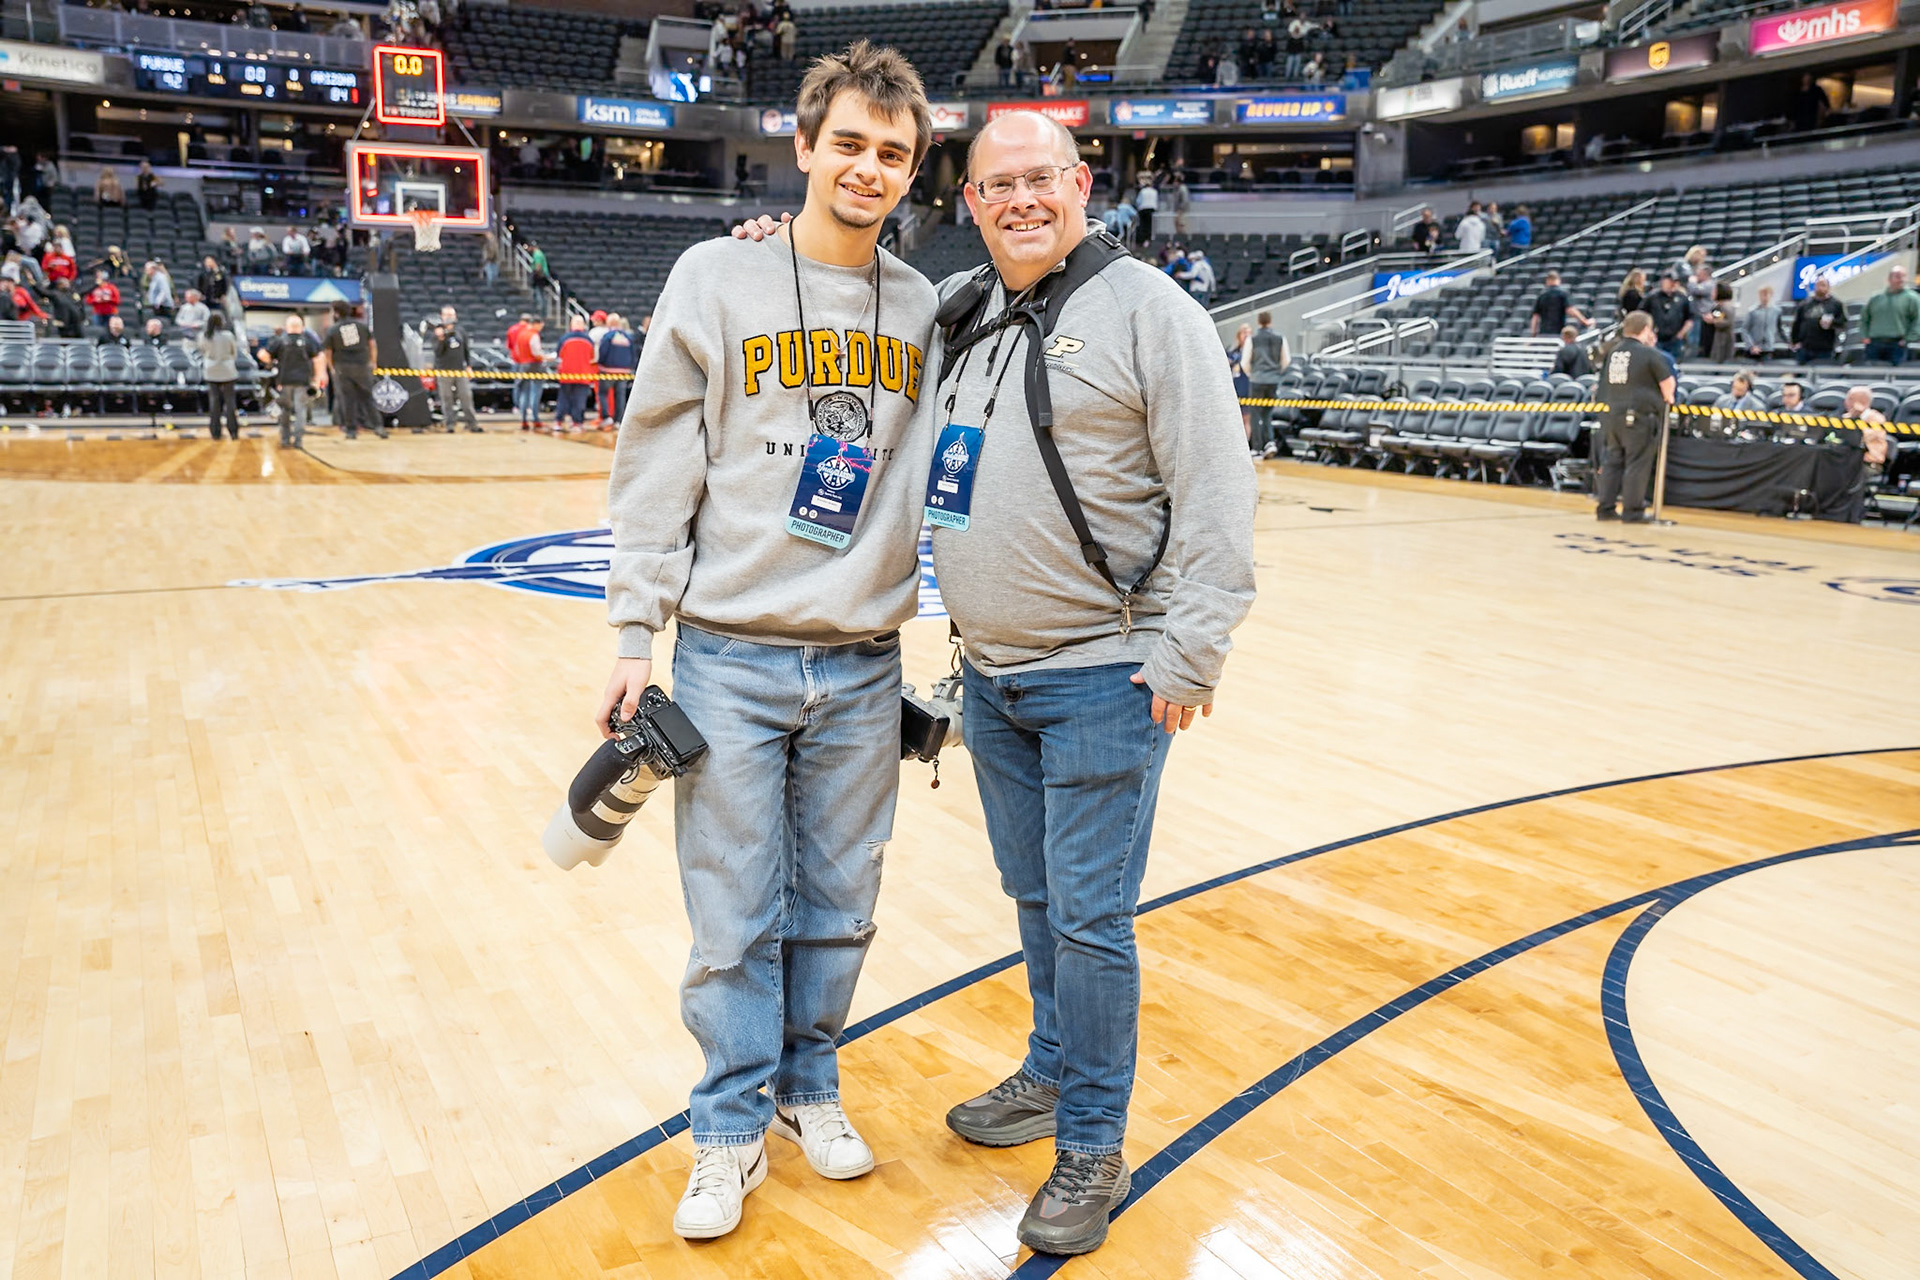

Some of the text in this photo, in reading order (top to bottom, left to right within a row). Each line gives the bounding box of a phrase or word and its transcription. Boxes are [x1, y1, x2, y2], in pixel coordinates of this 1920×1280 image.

[1806, 7, 1861, 41] mhs
[18, 51, 99, 75] Kinetico
[139, 54, 186, 74] PURDUE
[393, 54, 423, 76] 0.0
[310, 69, 357, 88] ARIZONA
[1499, 67, 1540, 92] Ruoff
[584, 98, 631, 124] ksm
[1300, 102, 1322, 117] UP
[1043, 334, 1086, 358] P
[743, 328, 923, 405] PURDUE
[927, 508, 967, 526] PHOTOGRAPHER
[790, 519, 846, 543] PHOTOGRAPHER
